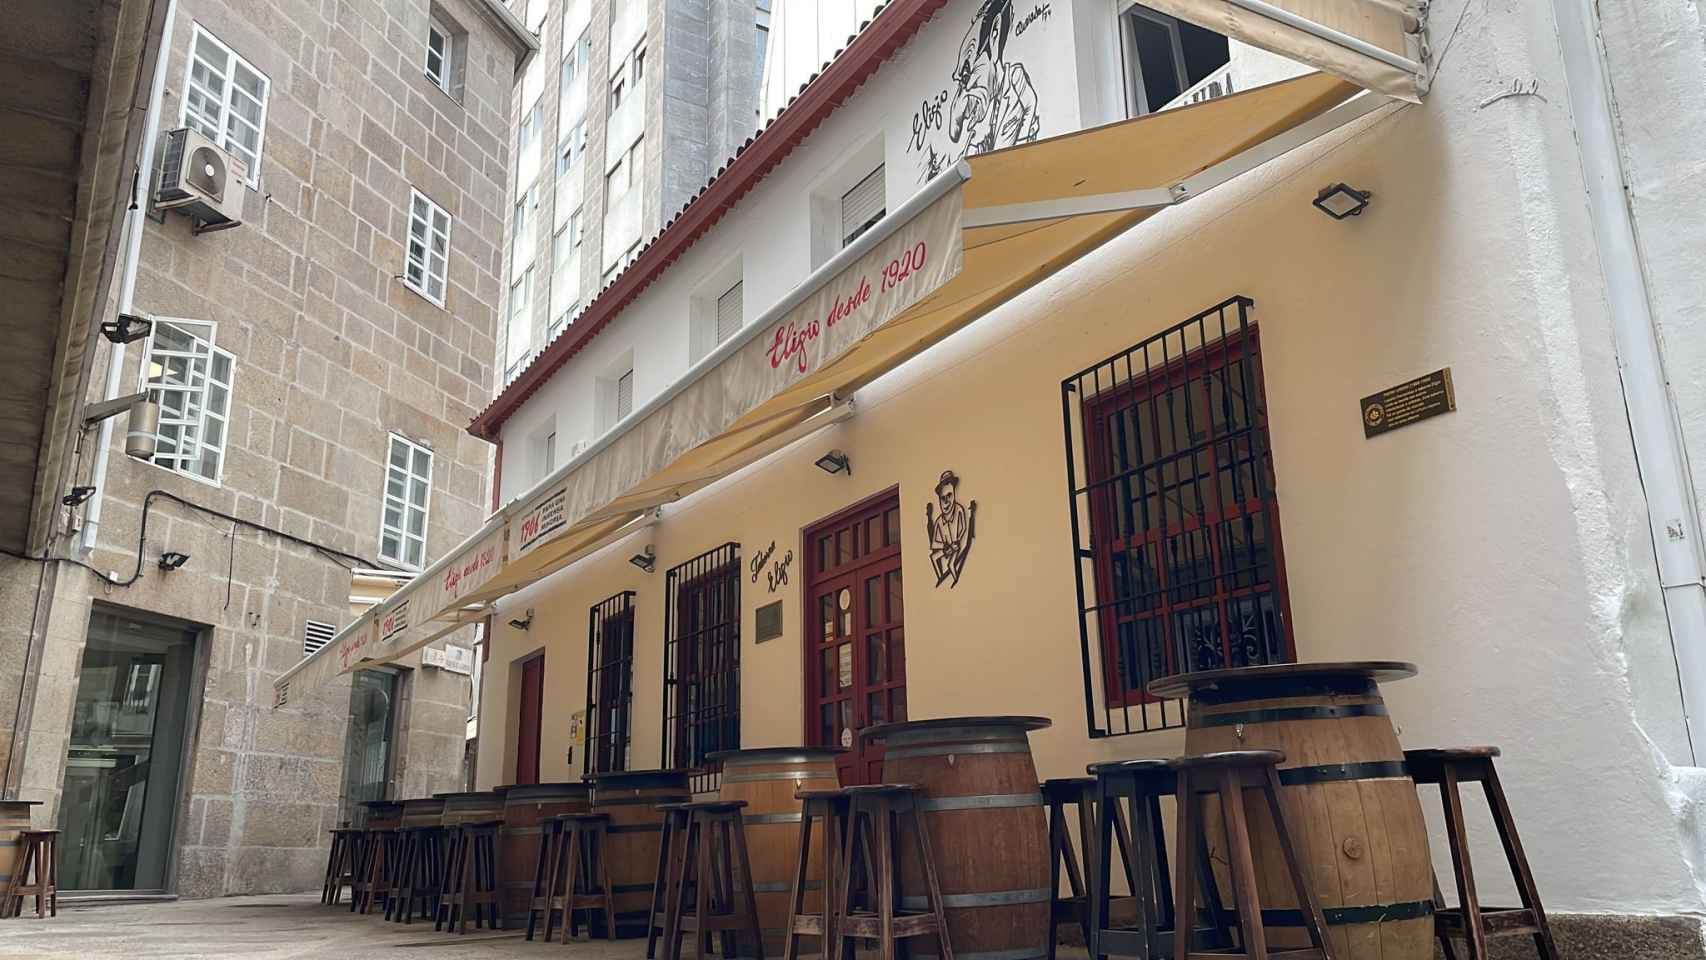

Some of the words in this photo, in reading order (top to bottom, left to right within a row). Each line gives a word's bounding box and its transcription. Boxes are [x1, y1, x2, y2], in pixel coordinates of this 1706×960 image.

[906, 89, 948, 153] Eligio
[767, 320, 821, 373] Eligio
[827, 275, 872, 327] desde
[880, 239, 927, 293] 1920
[520, 511, 541, 543] 1906
